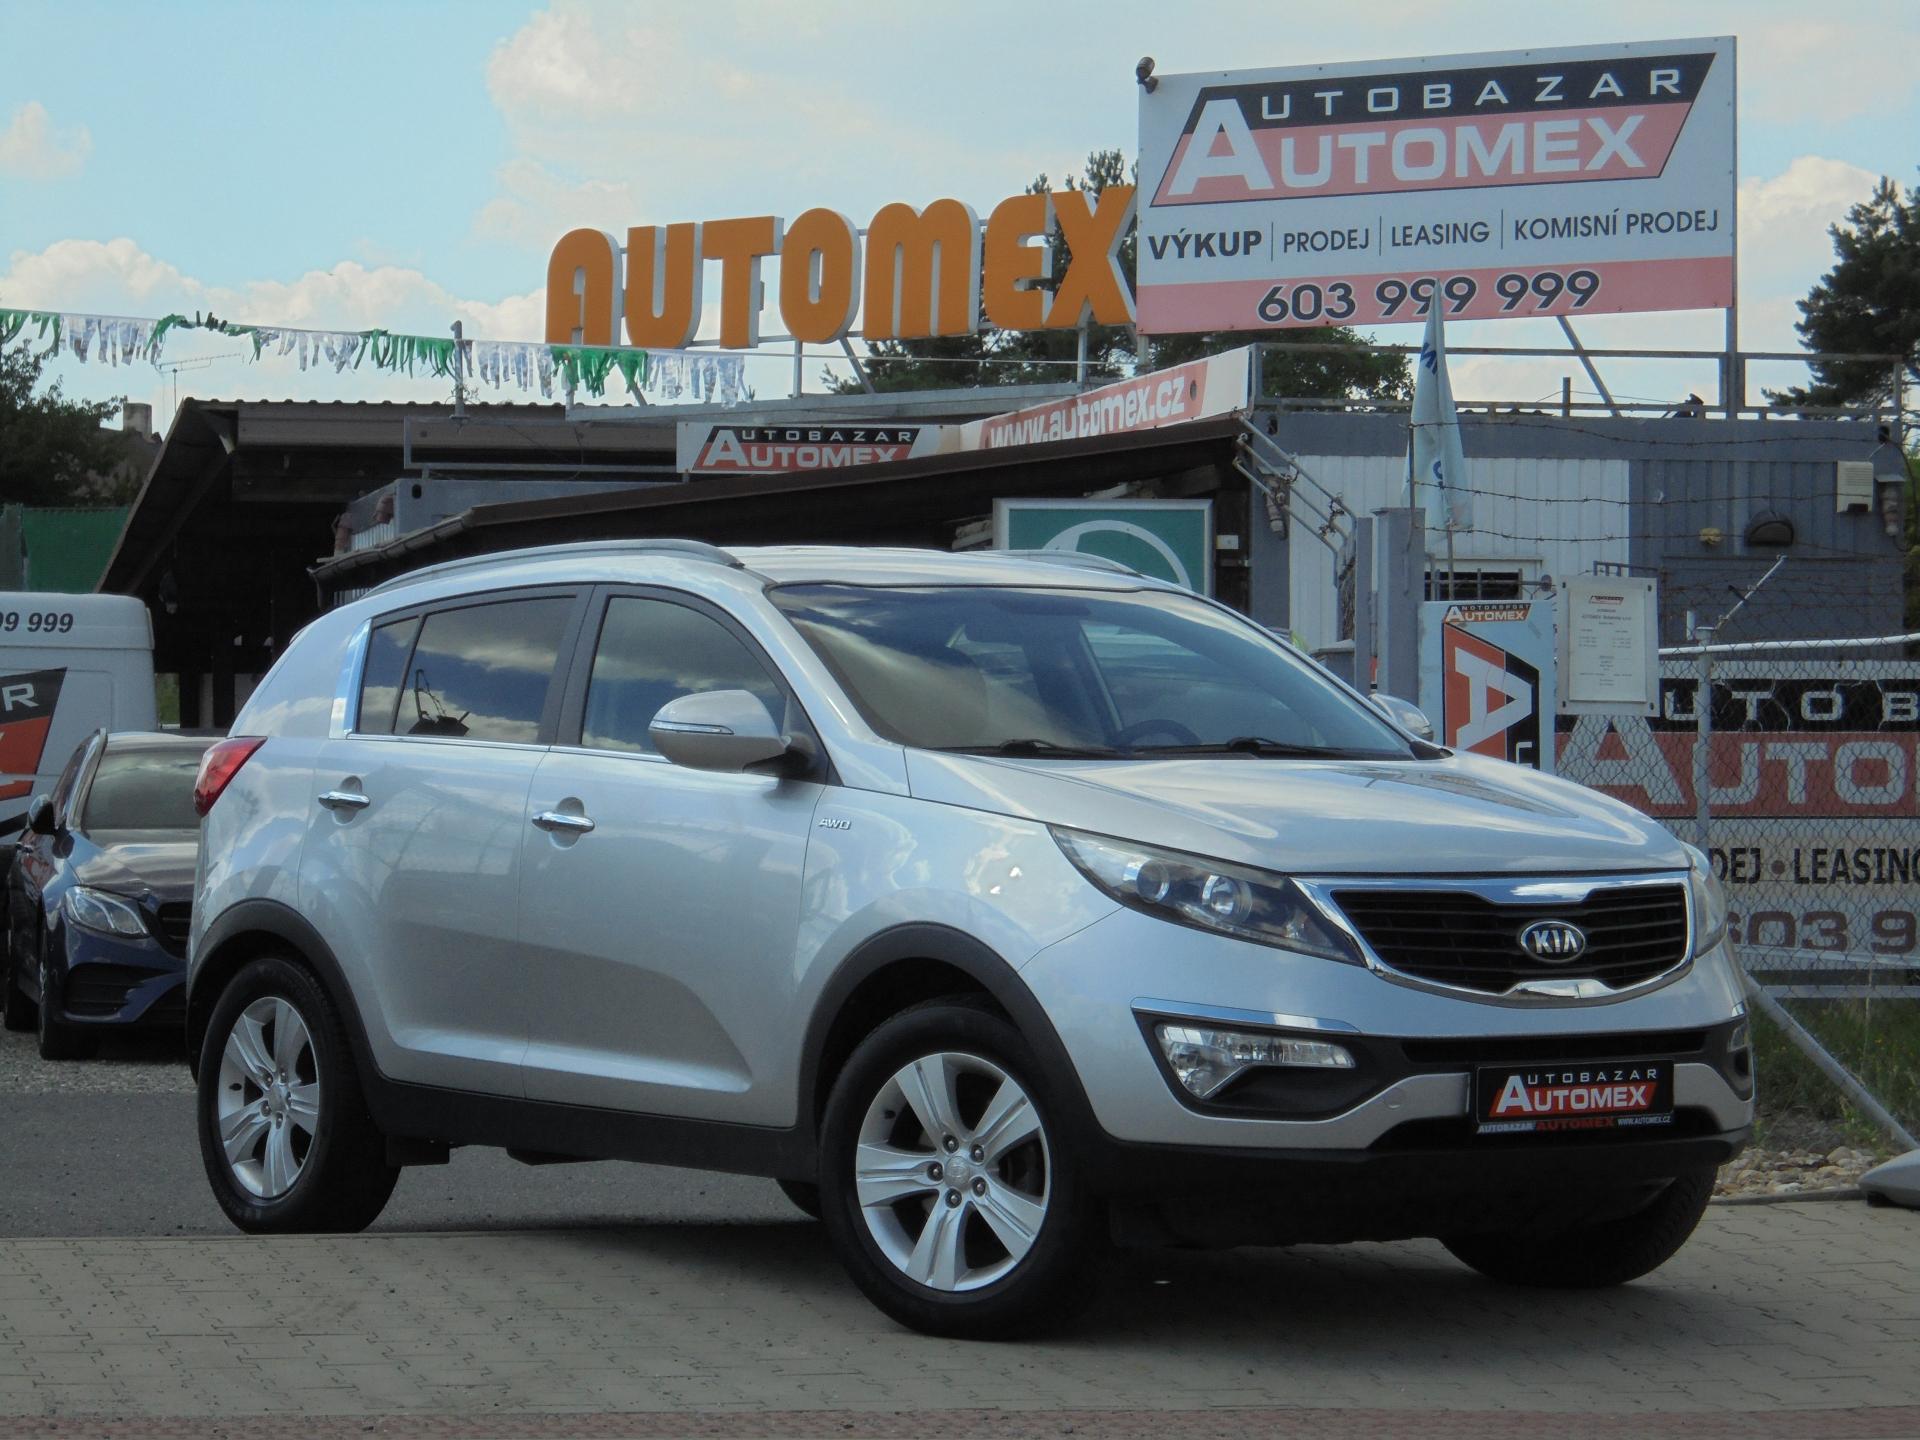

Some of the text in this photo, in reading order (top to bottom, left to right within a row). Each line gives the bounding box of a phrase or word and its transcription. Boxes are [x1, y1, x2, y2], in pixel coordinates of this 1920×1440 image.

[1167, 97, 1646, 197] AUTOMEX
[1147, 208, 1719, 261] VÝKUP PRODEJ LEASING KOMISNÍ PRODEJ
[545, 184, 1137, 350] AUTOMEX
[1257, 270, 1601, 323] 603 999 999
[991, 376, 1185, 448] www.automex.cz
[702, 430, 898, 468] AUTOMEX
[27, 612, 74, 633] 999
[1445, 606, 1525, 622] AUTOMEX
[819, 818, 852, 830] AWD
[1533, 930, 1578, 953] KIA
[1496, 1075, 1647, 1113] AUTOMEX
[1477, 1122, 1534, 1134] AUTOBAZAR
[1537, 1118, 1614, 1131] AUTOMEX
